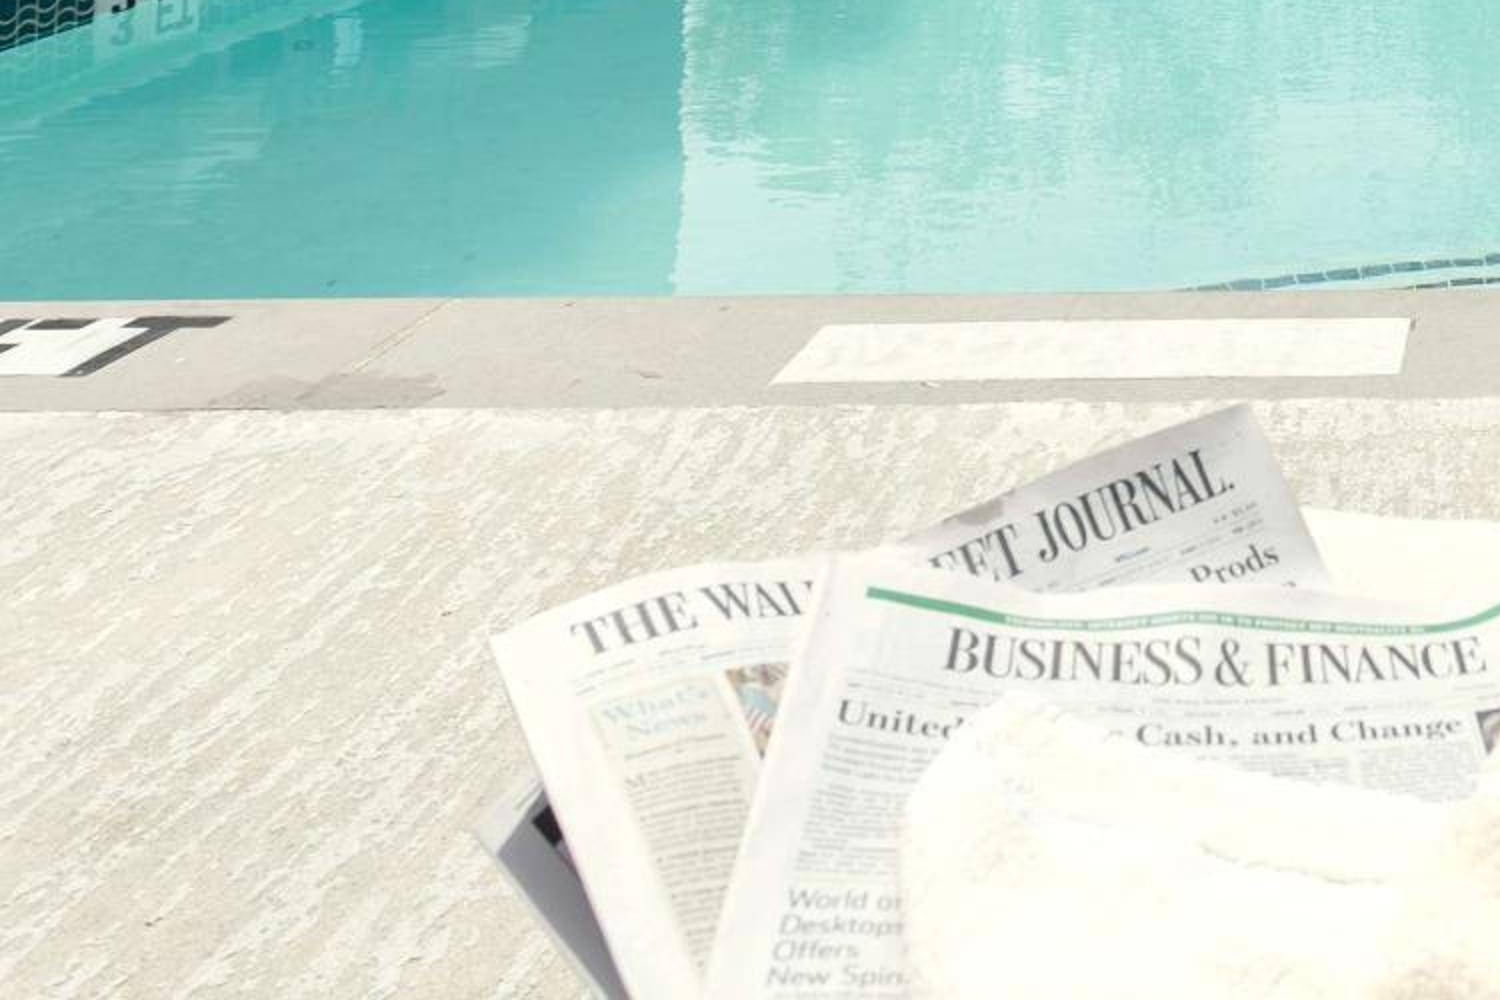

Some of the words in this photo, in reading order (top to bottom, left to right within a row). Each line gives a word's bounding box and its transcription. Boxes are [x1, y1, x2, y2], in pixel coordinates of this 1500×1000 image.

[570, 590, 699, 654] THE
[942, 626, 1204, 687] BUSINESS
[1214, 637, 1253, 688] &
[1263, 635, 1488, 688] FINANCE
[1136, 723, 1239, 749] Cash,
[1251, 722, 1319, 744] and
[1330, 717, 1463, 742] Change
[787, 886, 868, 910] World
[771, 939, 861, 962] Offers
[764, 965, 832, 989] New
